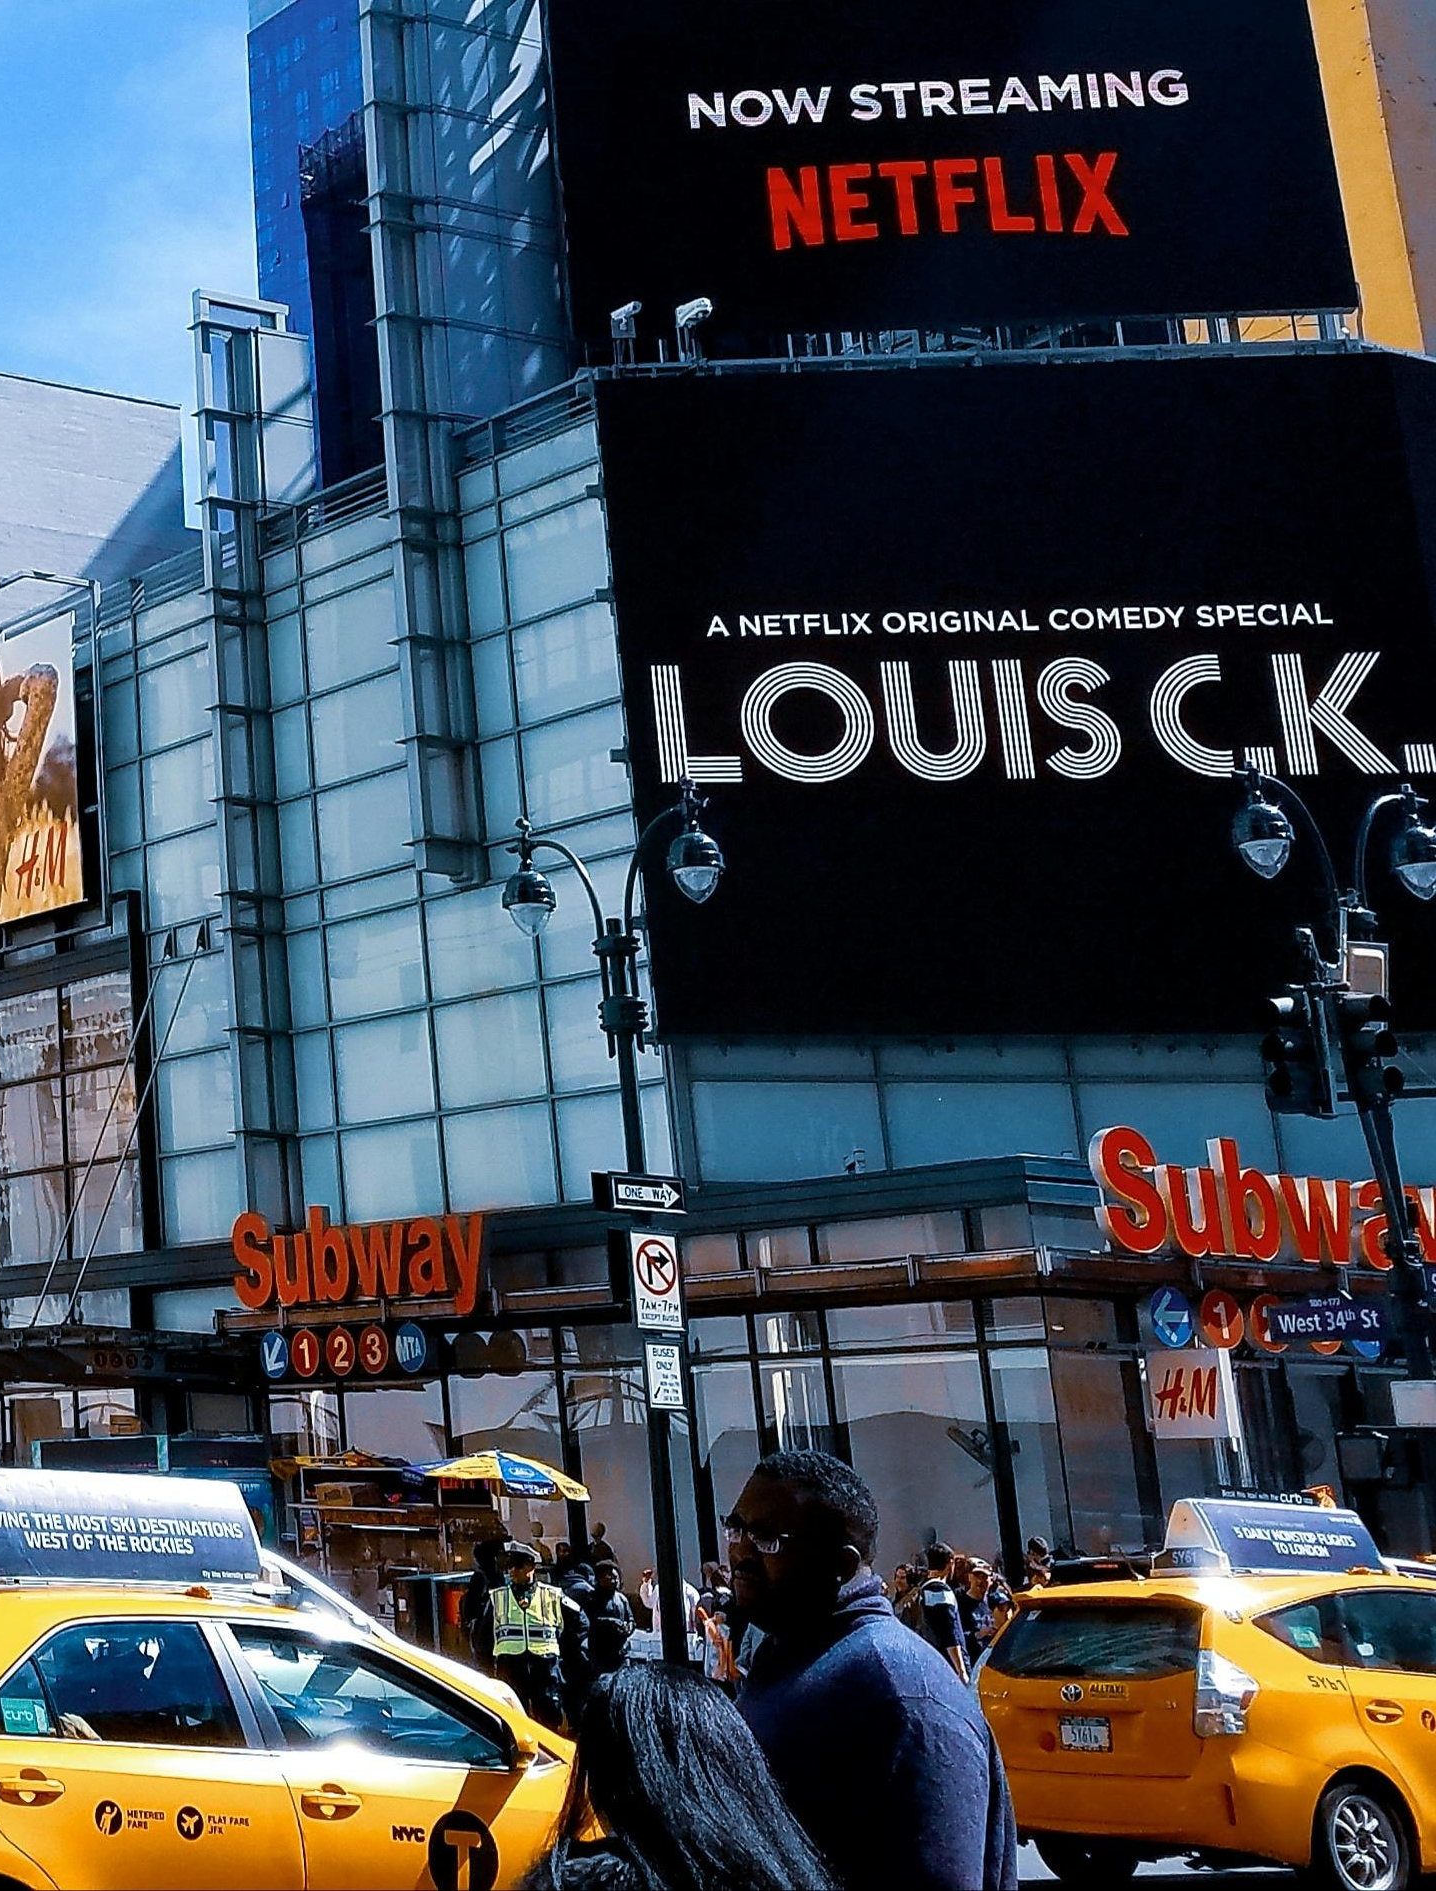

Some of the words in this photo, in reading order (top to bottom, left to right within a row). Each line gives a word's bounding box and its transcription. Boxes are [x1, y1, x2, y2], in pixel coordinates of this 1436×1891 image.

[687, 86, 832, 129] NOW
[850, 69, 1190, 119] STREAMING
[767, 151, 1129, 250] NETFLIX
[706, 615, 731, 637] A
[739, 612, 872, 636] NETFLIX
[882, 609, 1040, 633] ORIGINAL
[1049, 605, 1185, 630] COMEDY
[1196, 603, 1334, 627] SPECIAL
[650, 656, 1122, 782] LOUIS
[1150, 651, 1436, 778] C.K.
[15, 821, 68, 899] H&M
[624, 1186, 644, 1199] ONE
[651, 1187, 673, 1200] WAY
[231, 1206, 483, 1315] Subway
[640, 1298, 679, 1312] 7AM-7PM
[1213, 1301, 1230, 1339] 1
[1277, 1314, 1322, 1333] West
[1325, 1308, 1356, 1331] 34th
[1360, 1309, 1380, 1329] St
[299, 1338, 311, 1369] 1
[334, 1336, 349, 1368] 2
[366, 1333, 381, 1365] 3
[396, 1336, 423, 1362] MTA
[652, 1347, 675, 1358] BUSES
[656, 1361, 673, 1371] ONLY
[1154, 1366, 1217, 1421] H&M
[1279, 1493, 1302, 1504] curb
[31, 1512, 63, 1531] THE
[65, 1514, 108, 1533] MOST
[112, 1517, 135, 1534] SKI
[138, 1517, 244, 1539] DESTINATIONS
[24, 1531, 69, 1550] WEST
[71, 1533, 95, 1551] OF
[96, 1534, 130, 1552] THE
[130, 1536, 194, 1555] ROCKIES
[1234, 1526, 1243, 1539] 5
[1244, 1527, 1271, 1540] DAILY
[1271, 1529, 1317, 1544] NONSTOP
[1317, 1533, 1357, 1547] FLIGHTS
[1171, 1551, 1197, 1563] 5Y61
[1273, 1541, 1288, 1554] TO
[1288, 1543, 1331, 1557] LONDON
[1307, 1675, 1347, 1691] 5Y61
[5, 1710, 34, 1721] curb
[127, 1810, 165, 1820] METERED
[207, 1815, 226, 1825] FLAT
[229, 1817, 250, 1826] FARE
[127, 1820, 148, 1829] FARE
[208, 1827, 224, 1835] JFK
[392, 1825, 426, 1842] NYC
